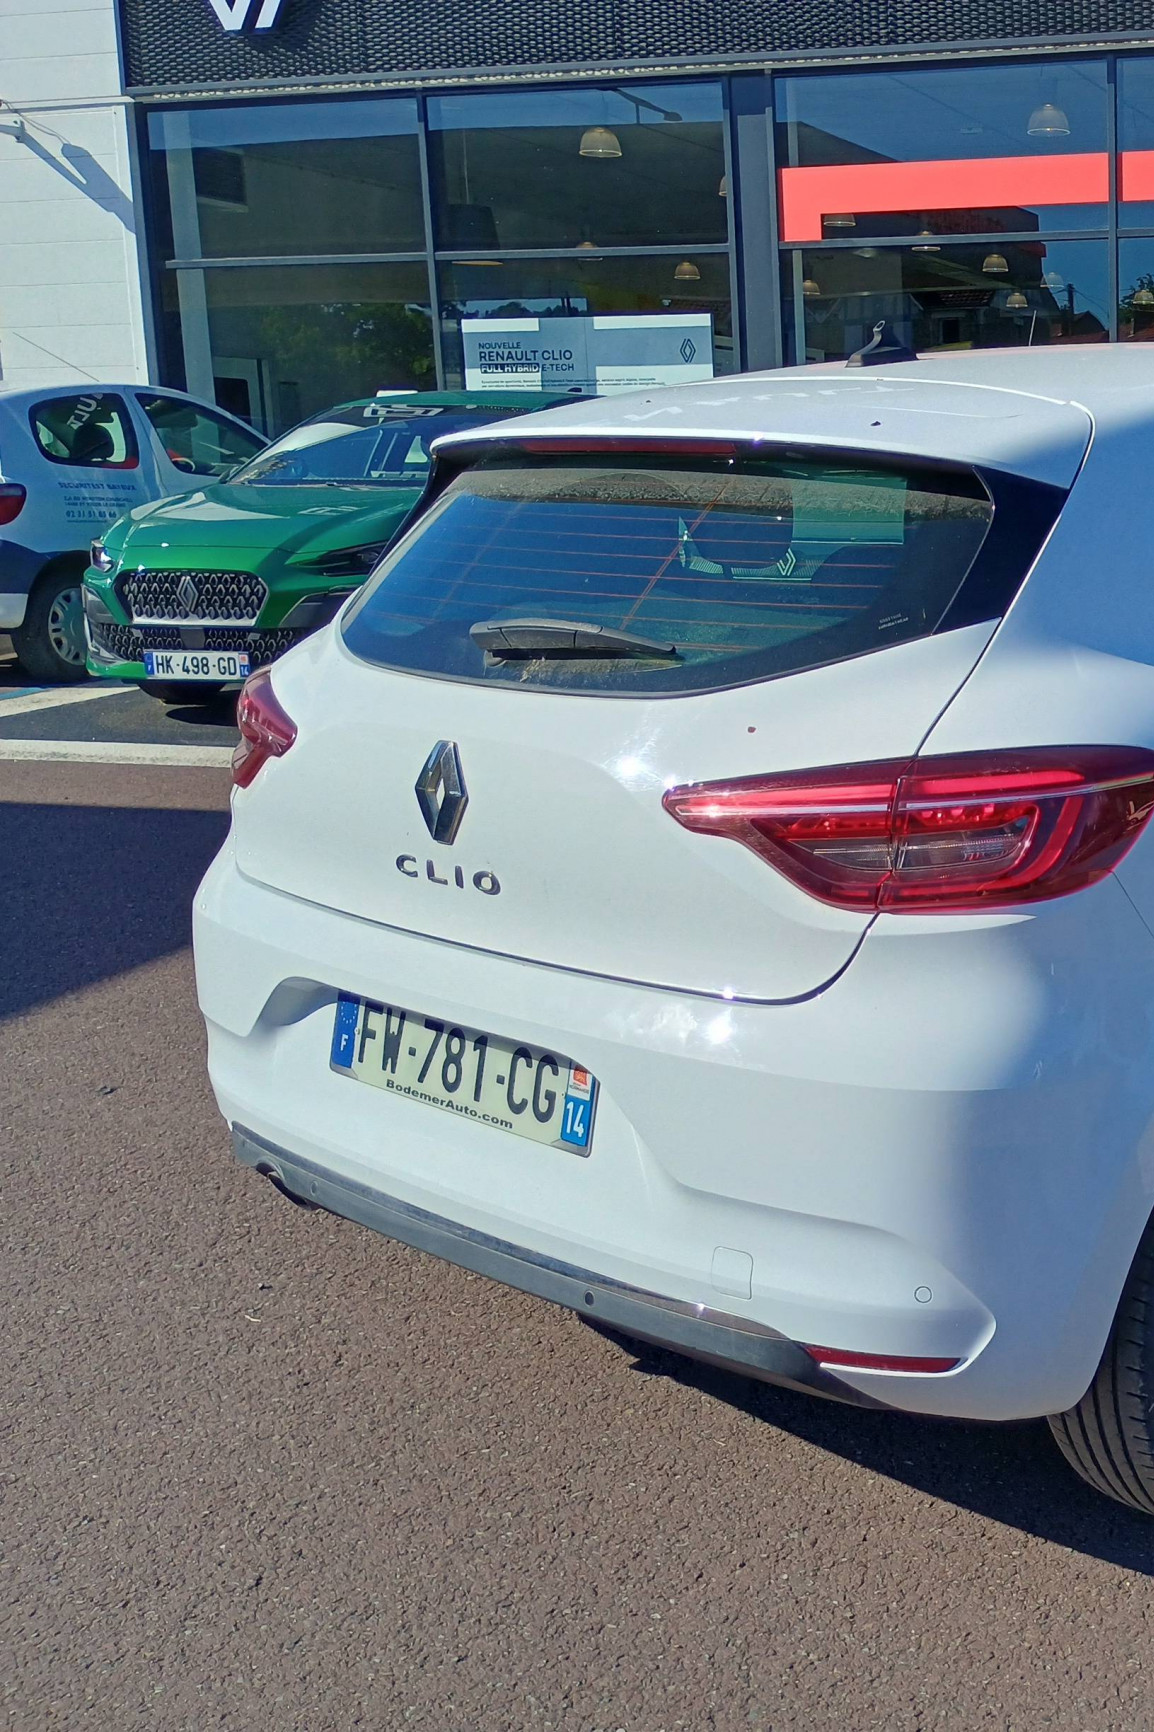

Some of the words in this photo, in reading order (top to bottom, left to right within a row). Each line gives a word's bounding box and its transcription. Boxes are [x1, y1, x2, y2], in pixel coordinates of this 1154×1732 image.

[478, 341, 521, 350] NOUVELLE
[479, 350, 539, 362] RENAULT
[541, 349, 573, 361] CLIO
[481, 364, 503, 373] FULL
[504, 363, 539, 373] HYBRID
[541, 363, 575, 372] E-TECH
[155, 655, 237, 676] HK-498-GD
[396, 854, 501, 896] CLIO
[340, 1033, 349, 1052] F
[357, 1000, 559, 1124] FW-781-CG
[385, 1078, 513, 1130] BodemerAuto.com
[566, 1101, 585, 1138] 14
